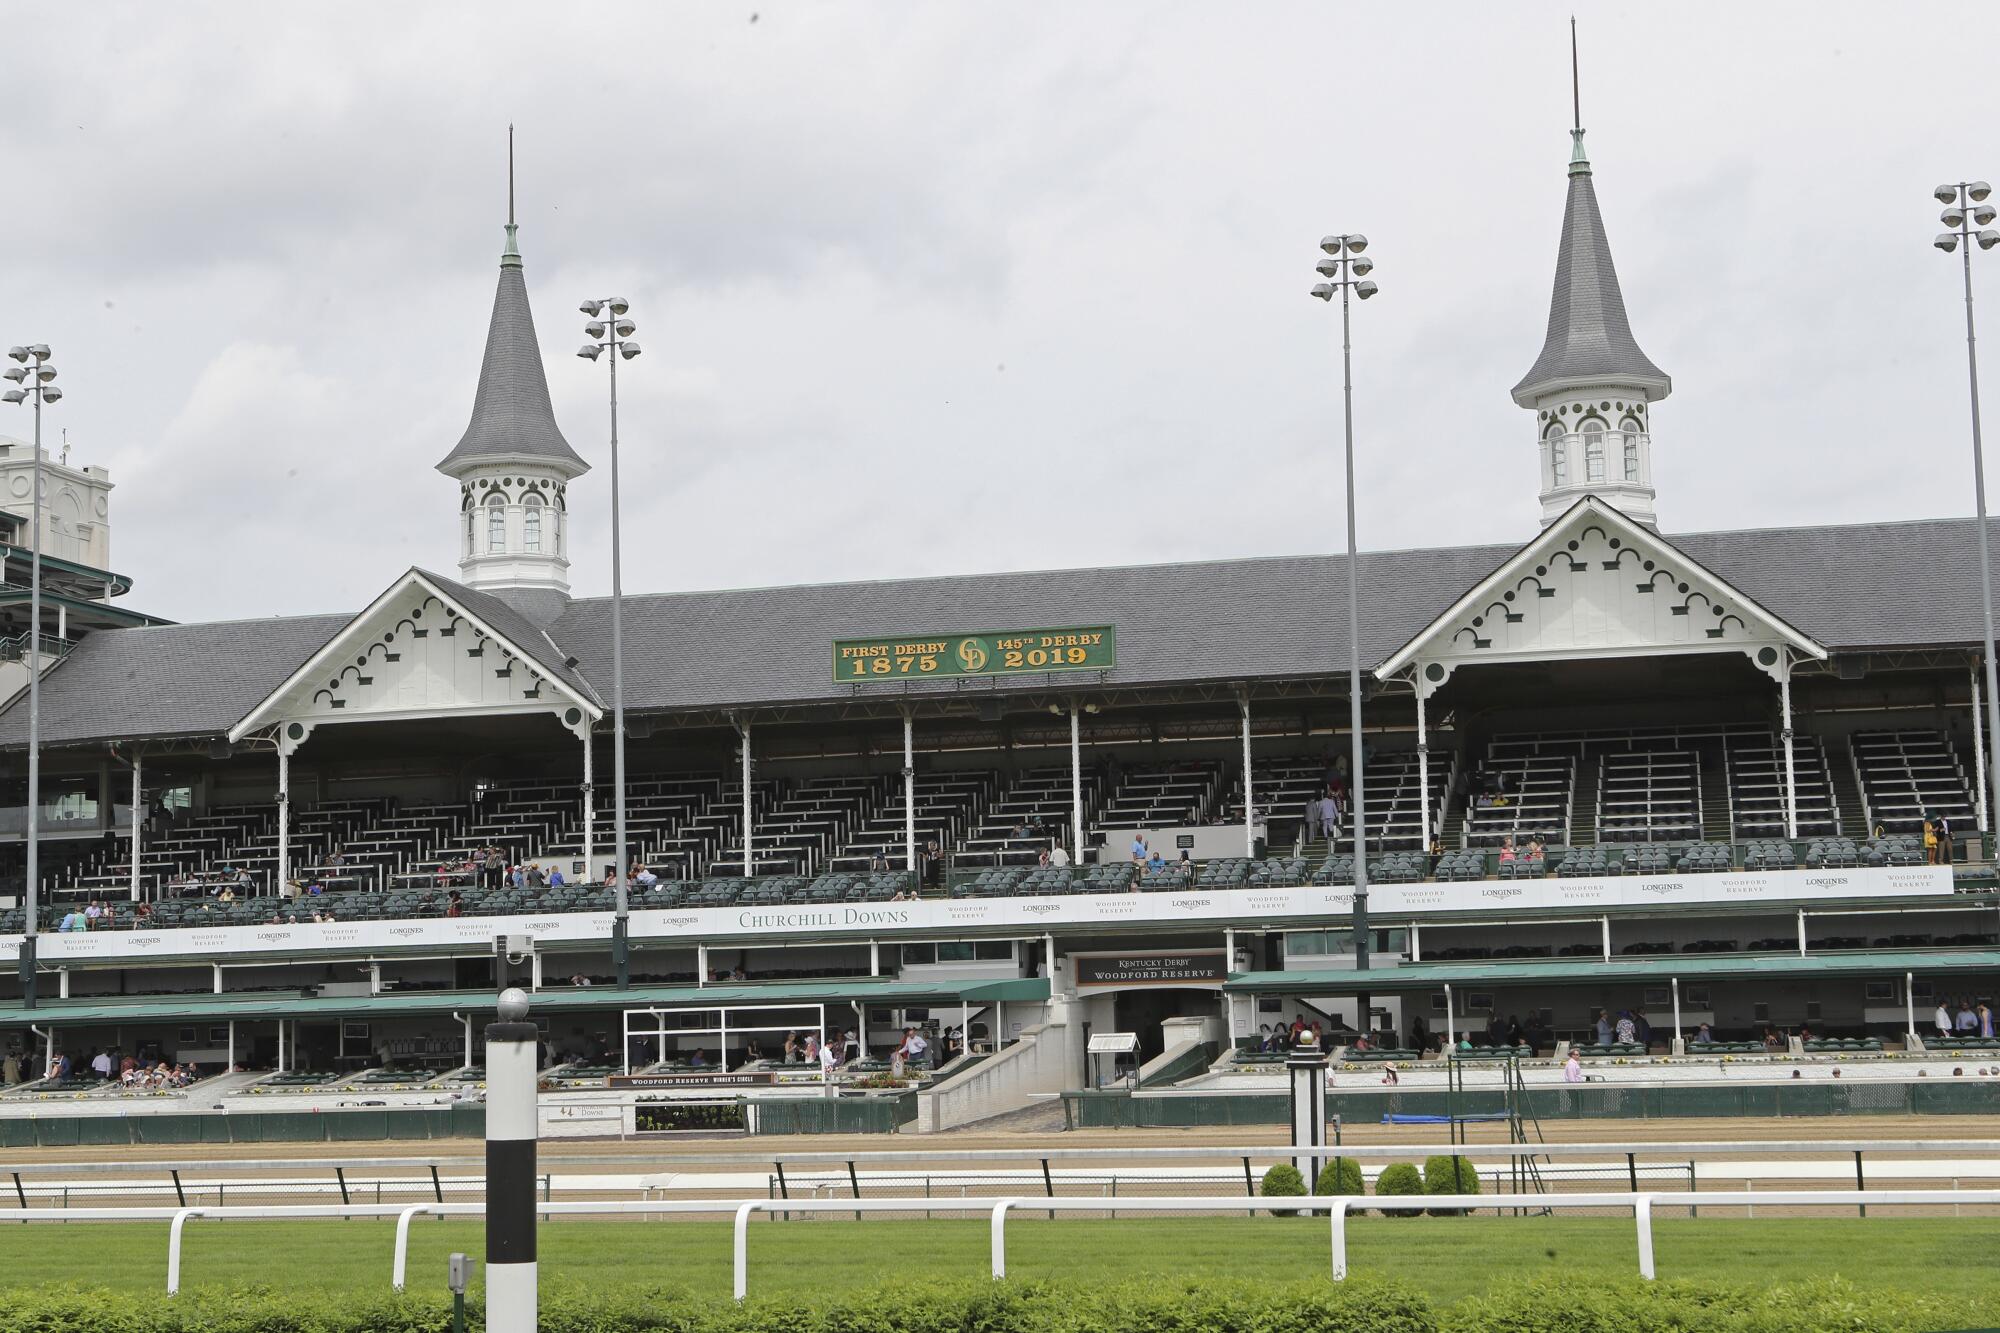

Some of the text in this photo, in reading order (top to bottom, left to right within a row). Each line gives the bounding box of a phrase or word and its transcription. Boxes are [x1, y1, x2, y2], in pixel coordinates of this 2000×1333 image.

[1040, 633, 1102, 648] DERBY
[842, 642, 948, 658] FIRST DERBY
[1005, 647, 1087, 667] 2019
[853, 655, 938, 675] 1875
[1806, 877, 1848, 885] LONGINES
[1642, 883, 1683, 891] LONGINES
[1482, 888, 1522, 896] LONGINES
[1172, 899, 1211, 907] LONGINES
[739, 908, 908, 928] CHURCHILL DOWNS
[389, 927, 424, 935] LONGINES
[257, 932, 291, 940] LONGINES
[128, 937, 161, 945] LONGINES
[1119, 959, 1161, 968] KENTUCKY
[1164, 958, 1190, 967] DERBY
[1095, 970, 1214, 980] WOODFORD RESERVE
